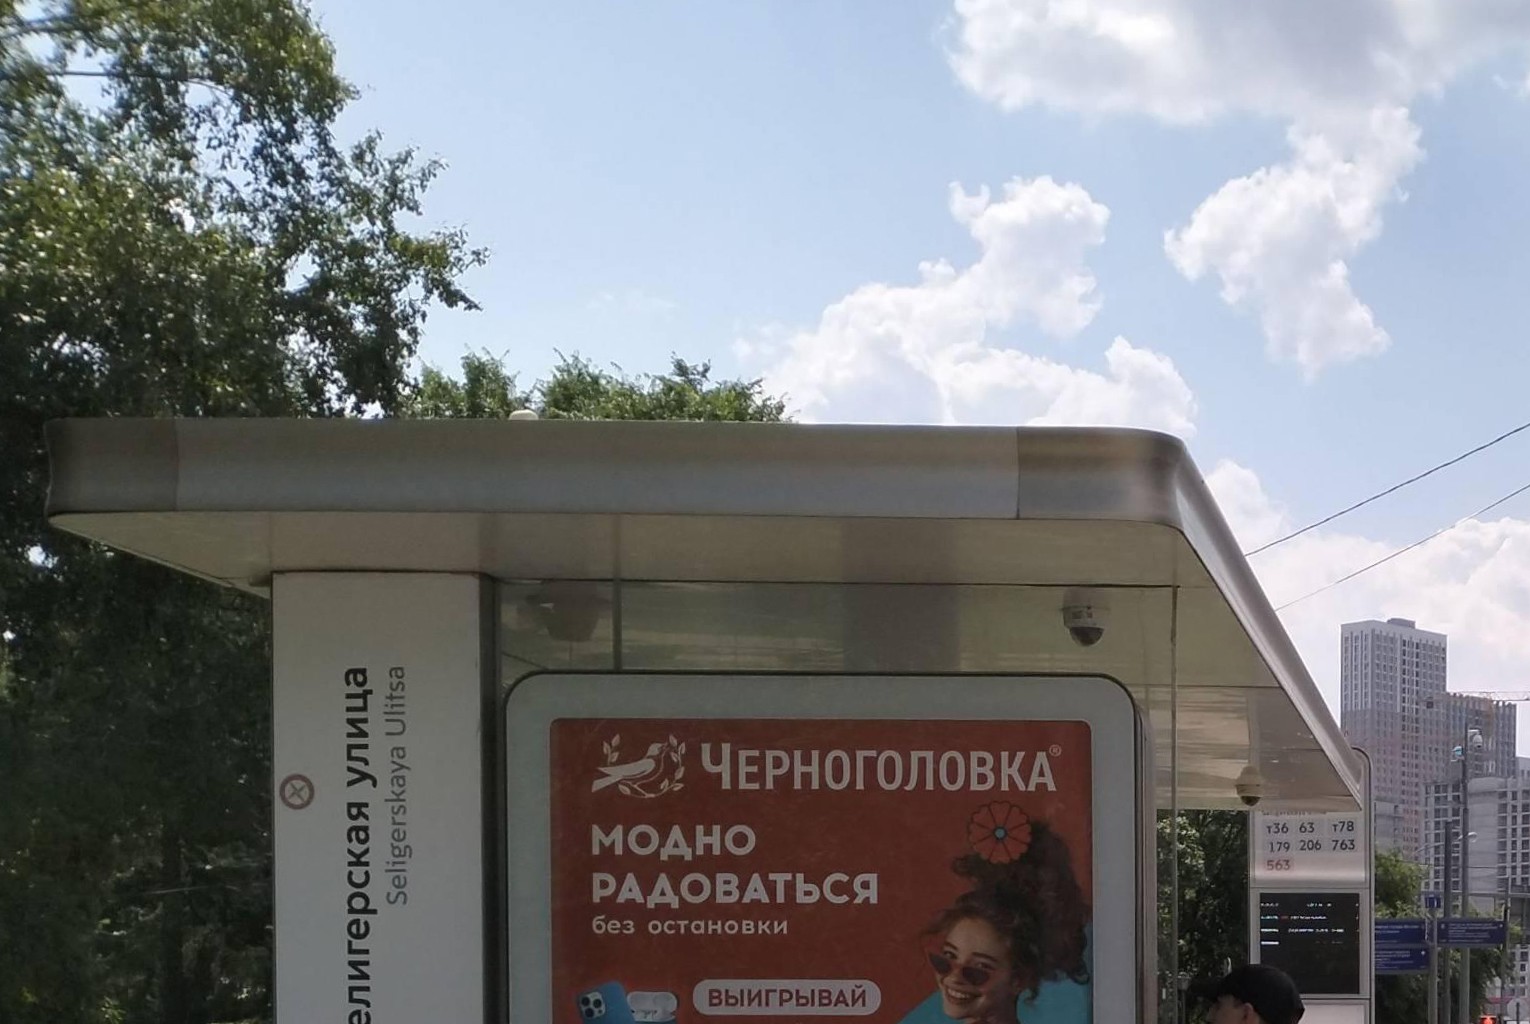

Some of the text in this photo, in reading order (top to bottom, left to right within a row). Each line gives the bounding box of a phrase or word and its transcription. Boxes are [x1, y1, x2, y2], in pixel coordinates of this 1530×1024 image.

[342, 667, 377, 790] улица
[701, 742, 1058, 792] ЧЕРНОГОЛОВКА
[386, 665, 412, 906] Seligerskaya Ulitsa
[591, 824, 756, 860] МОДНО
[1299, 822, 1315, 834] 63
[1269, 839, 1355, 853] 179 206 763
[1266, 859, 1291, 871] 563
[591, 871, 879, 909] РАДОВАТЬСЯ
[592, 915, 789, 935] без остановки
[708, 984, 867, 1008] ВЫИГРЫВАЙ
